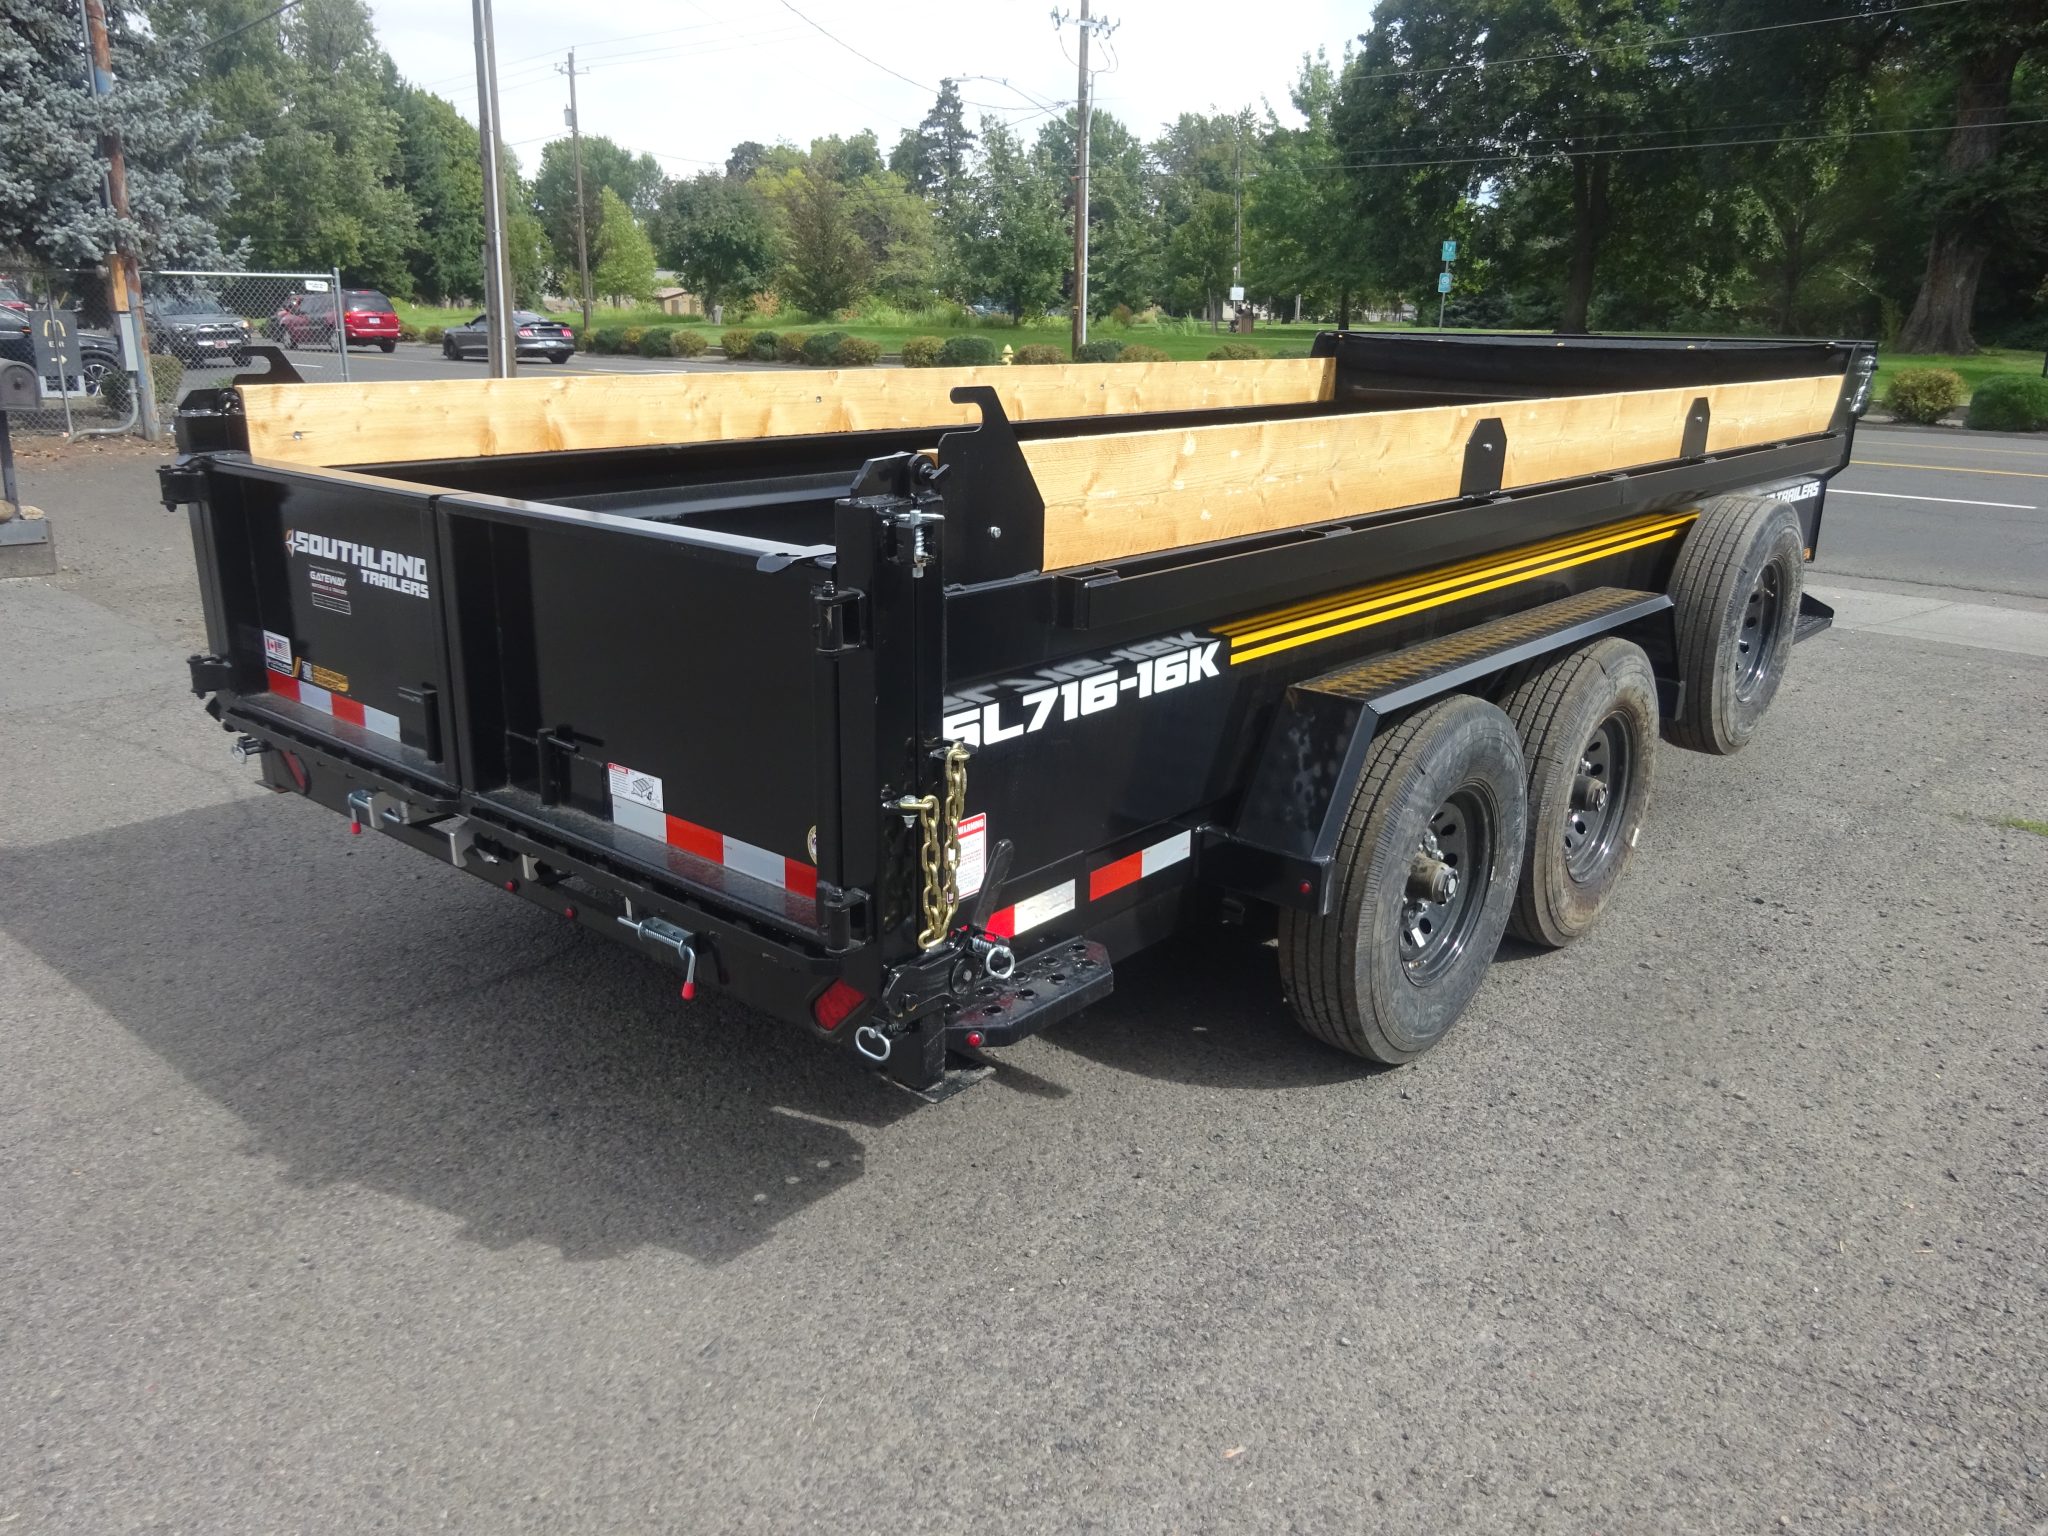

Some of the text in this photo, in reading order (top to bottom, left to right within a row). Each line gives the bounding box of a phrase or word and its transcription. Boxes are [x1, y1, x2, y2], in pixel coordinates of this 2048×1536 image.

[48, 340, 65, 348] Eit
[1776, 481, 1821, 503] TRAILERS
[294, 530, 428, 582] SOUTHLAND
[309, 571, 347, 587] GATEWAY
[360, 568, 430, 599] TRAILERS
[942, 640, 1221, 748] SL716-16K
[957, 818, 984, 836] WARNING
